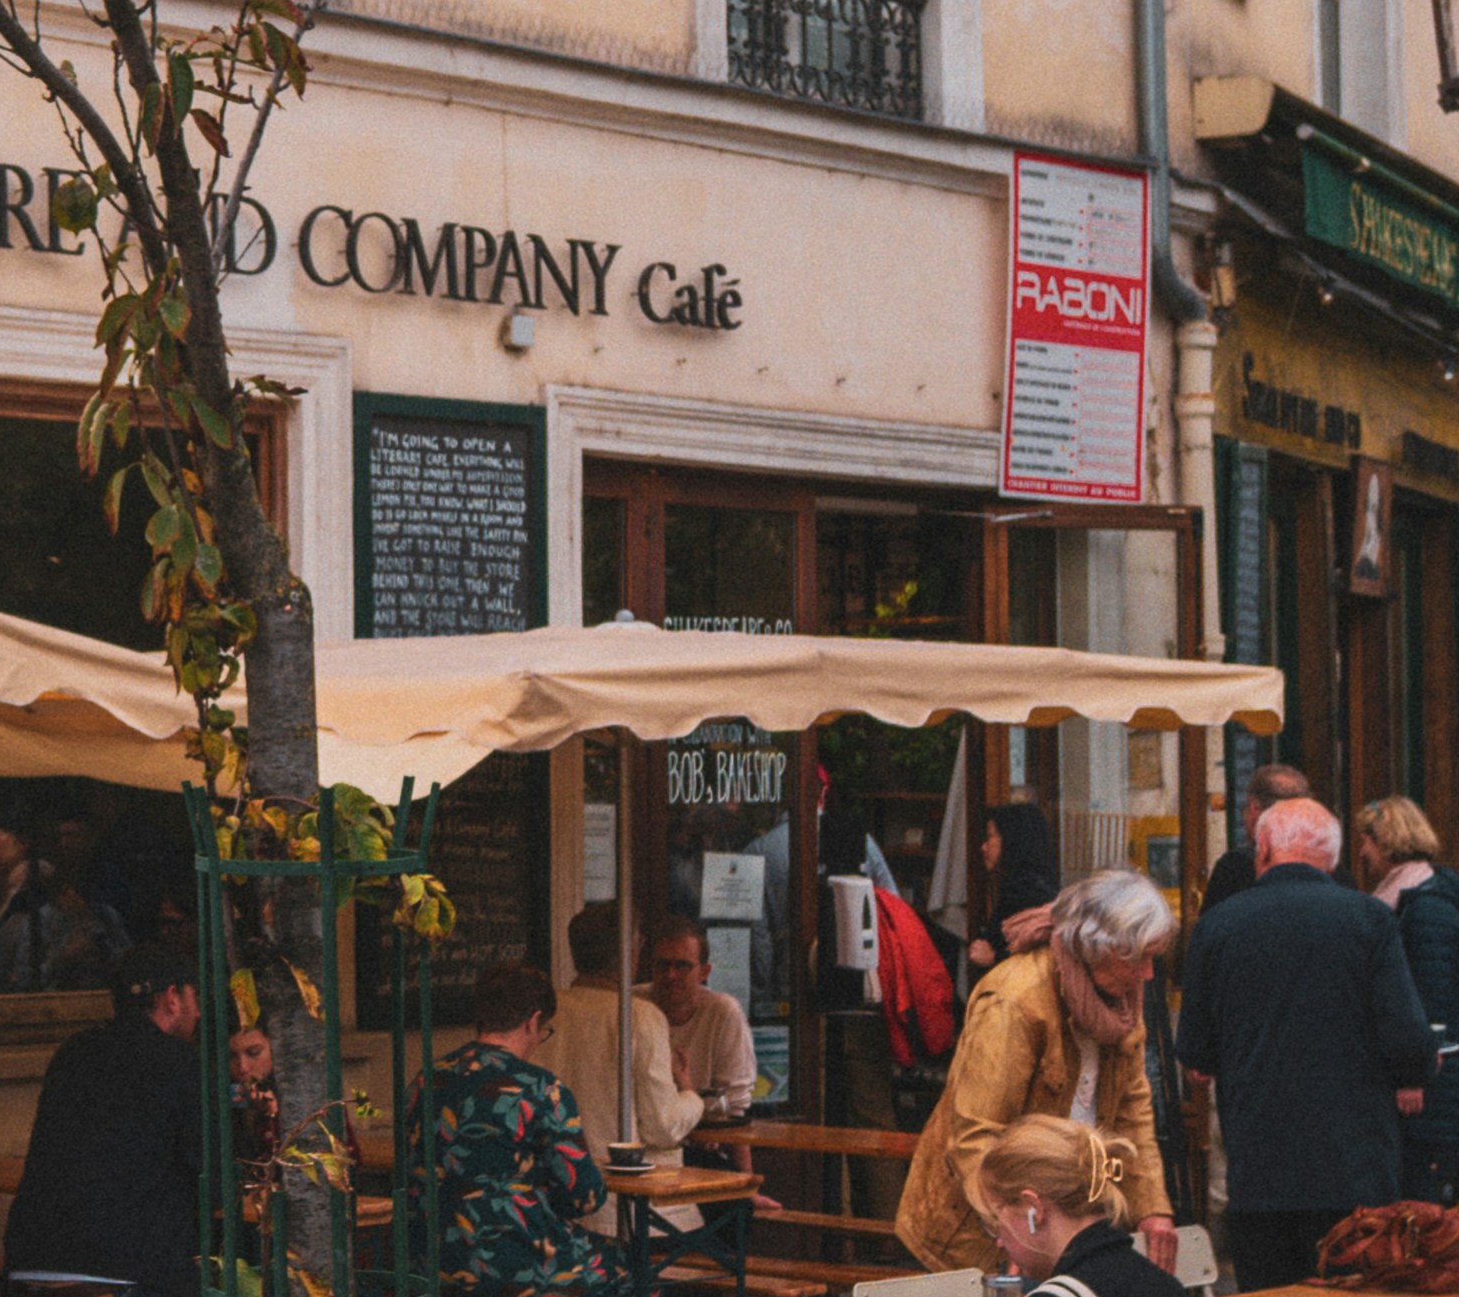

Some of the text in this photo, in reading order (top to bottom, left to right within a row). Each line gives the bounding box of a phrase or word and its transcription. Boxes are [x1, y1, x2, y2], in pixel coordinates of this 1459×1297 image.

[296, 204, 621, 317] COMPANY
[633, 262, 743, 332] Café
[1016, 270, 1142, 325] RABONI
[402, 434, 439, 451] GOING
[444, 436, 458, 449] TO
[463, 437, 496, 452] OPEN
[503, 442, 512, 453] A
[471, 542, 521, 560] ENOUGH
[485, 563, 521, 581] STORE
[715, 749, 788, 805] BAKESHOP
